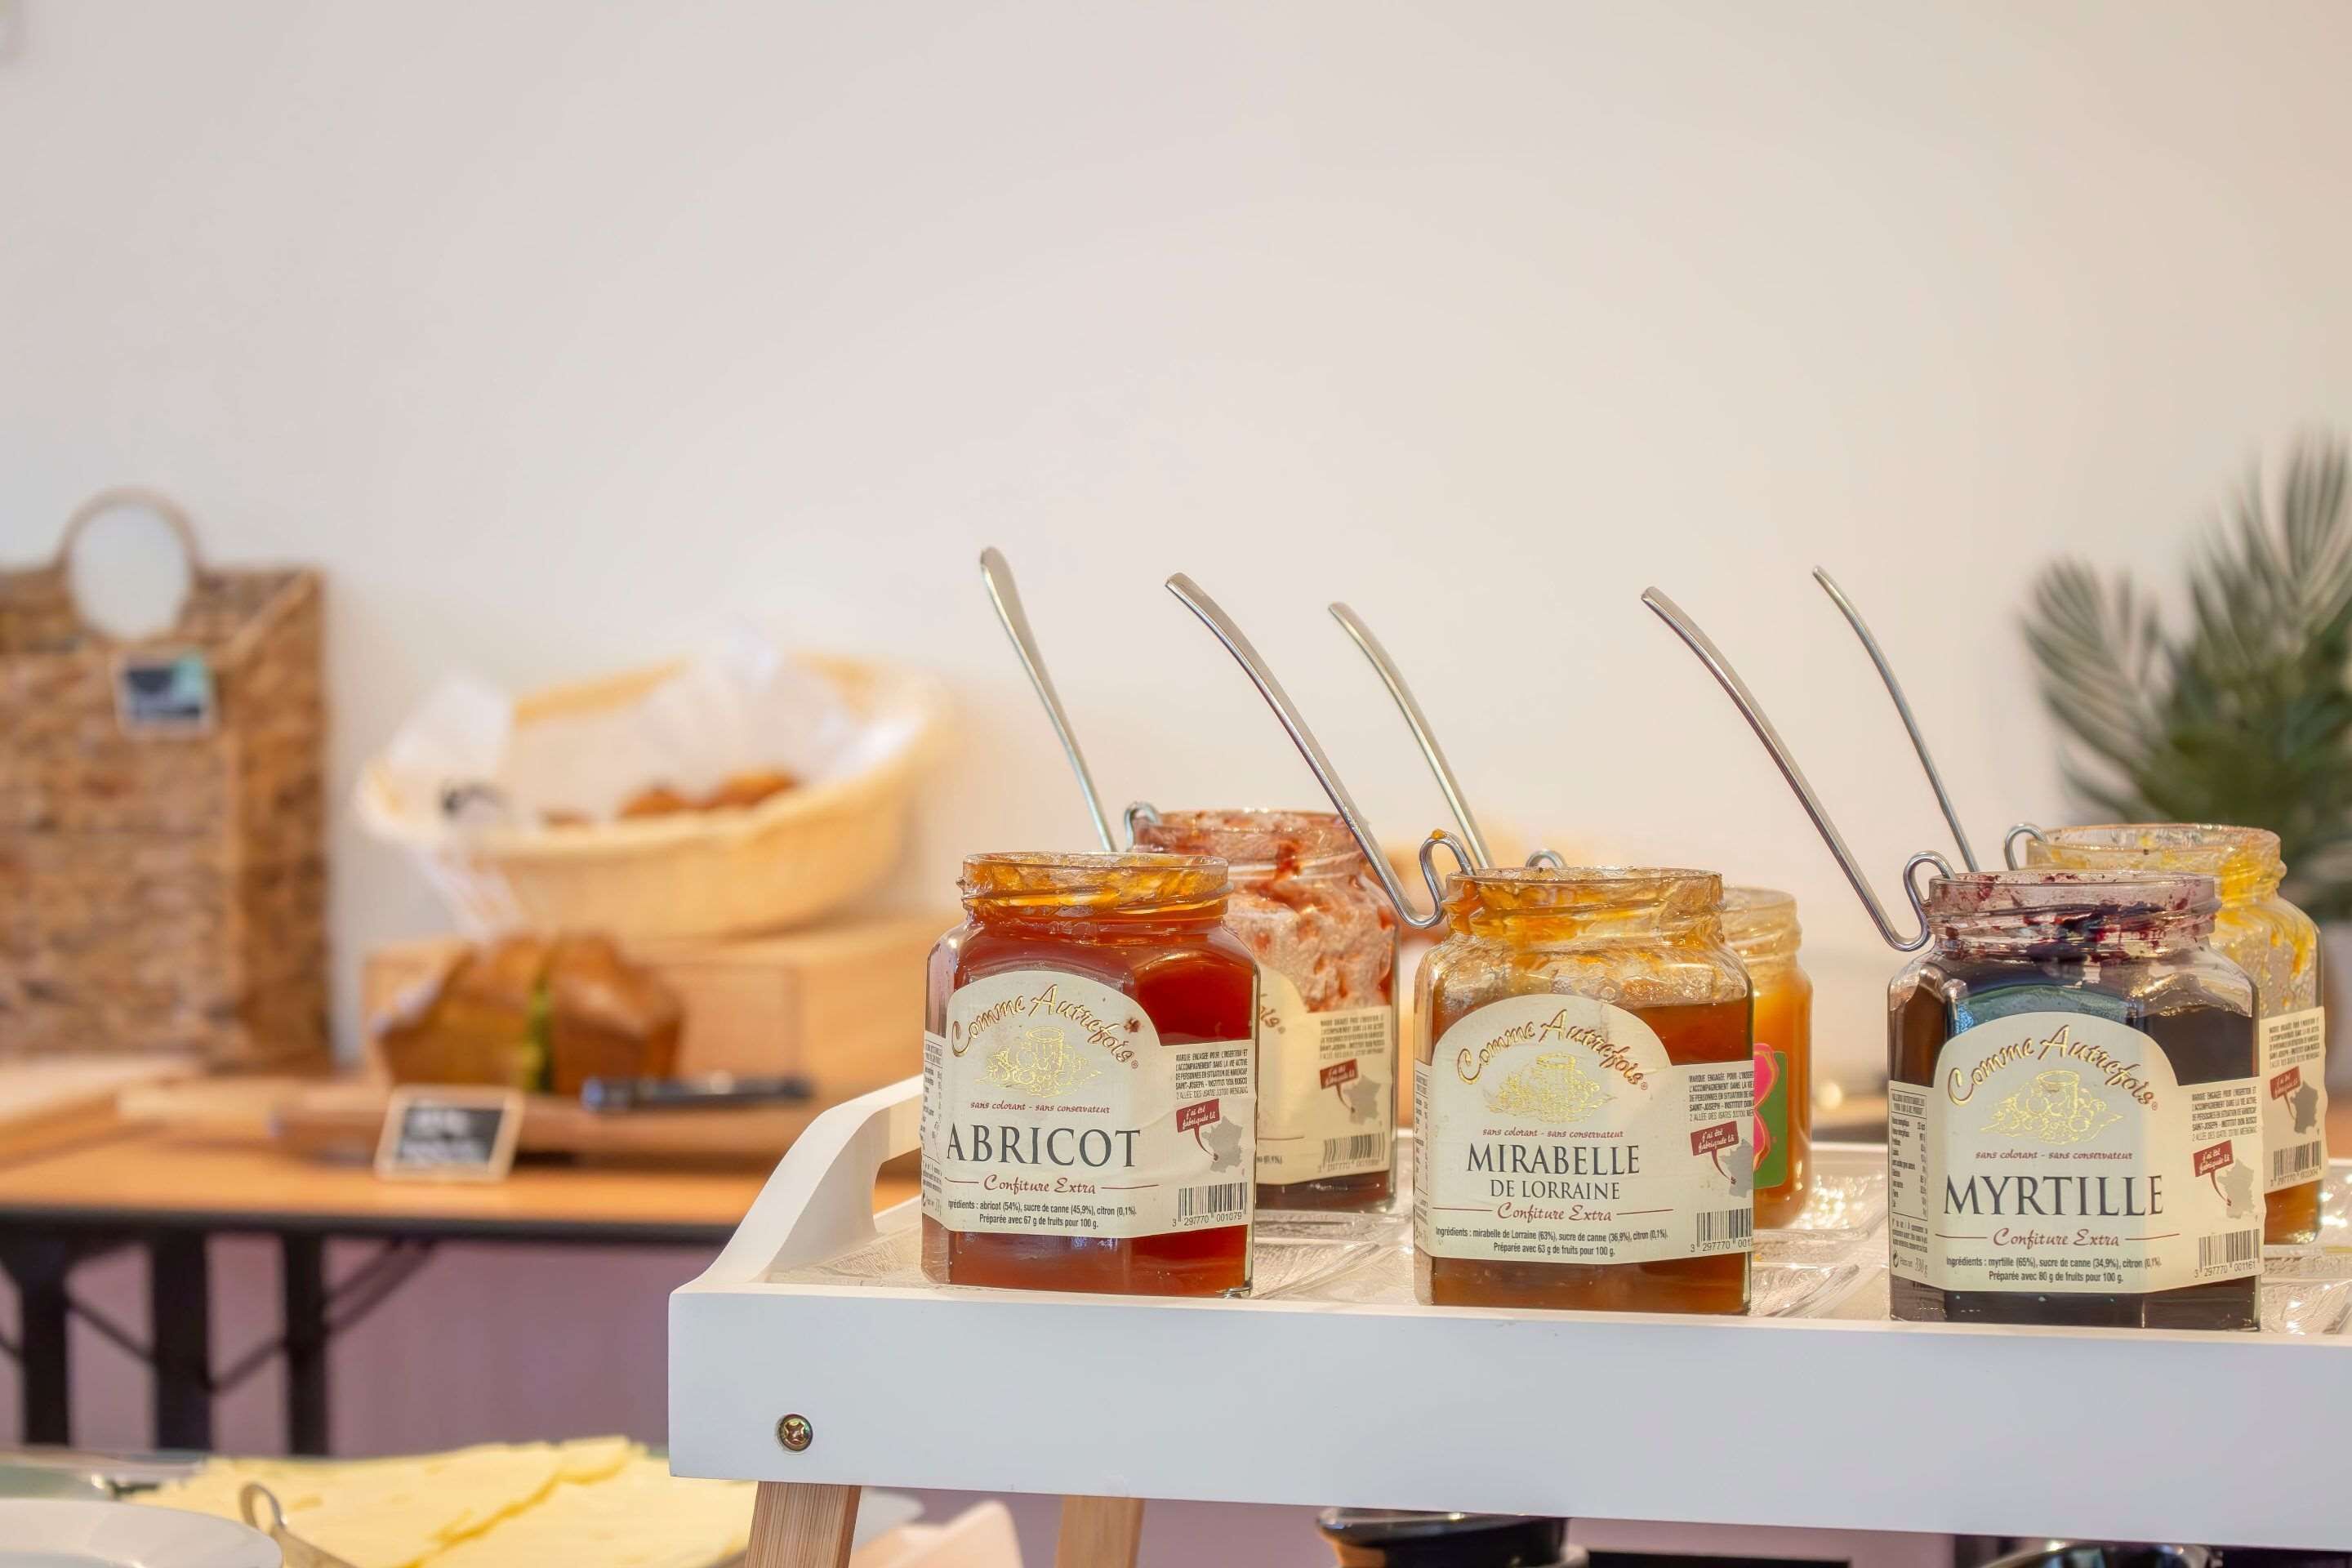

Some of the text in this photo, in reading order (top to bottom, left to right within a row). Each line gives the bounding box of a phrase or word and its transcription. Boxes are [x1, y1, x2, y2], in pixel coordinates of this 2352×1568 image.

[951, 995, 1026, 1058] Comme
[1457, 1021, 1536, 1085] Comme
[1948, 1038, 2034, 1107] Comme
[991, 1100, 1026, 1111] colorant
[1035, 1104, 1054, 1112] sans
[1057, 1104, 1110, 1114] conservateur
[1504, 1127, 1538, 1137] colorant
[1569, 1129, 1624, 1139] conservateur
[946, 1122, 1141, 1168] ABRICOT
[1466, 1143, 1640, 1176] MIRABELLE
[1976, 1151, 1997, 1160] sans
[2000, 1148, 2038, 1160] colorant
[2049, 1152, 2070, 1160] sans
[2073, 1151, 2133, 1160] conservateur
[983, 1174, 1096, 1196] Confiture Extra
[1490, 1179, 1620, 1200] DE LORRAINE
[1944, 1174, 2163, 1216] MYRTILLE
[980, 1201, 1001, 1210] abricot
[1003, 1202, 1022, 1213] (54%),
[1042, 1204, 1049, 1212] de
[1051, 1205, 1069, 1214] canne
[1097, 1206, 1115, 1215] citron
[1497, 1202, 1612, 1223] Confiture Extra
[980, 1214, 1007, 1225] Préparée
[1023, 1216, 1031, 1224] 67
[1033, 1217, 1037, 1226] g
[1038, 1216, 1046, 1225] de
[1048, 1216, 1063, 1226] fruits
[1065, 1219, 1079, 1228] pour
[1080, 1218, 1091, 1227] 100
[1172, 1212, 1242, 1227] 3 297770 001079
[1436, 1226, 1468, 1238] Ingrédients
[1473, 1228, 1501, 1238] mirabelle
[1503, 1229, 1510, 1238] de
[1511, 1229, 1536, 1239] Lorraine
[1538, 1231, 1557, 1241] (63%),
[1559, 1233, 1576, 1241] sucre
[1578, 1232, 1585, 1242] de
[1587, 1234, 1606, 1242] canne
[1633, 1230, 1649, 1240] citron
[1993, 1228, 2119, 1250] Confiture Extra
[1494, 1242, 1615, 1257] Préparée avec 63 g de fruits pour 100 g.
[1690, 1244, 1695, 1253] 3
[1702, 1241, 1731, 1252] 297770
[1946, 1256, 1982, 1268] Ingrédients
[1988, 1257, 2013, 1268] myrtille
[2016, 1257, 2038, 1268] (65%),
[2039, 1258, 2058, 1267] sucre
[2060, 1258, 2068, 1267] de
[2070, 1258, 2091, 1267] canne
[2122, 1258, 2143, 1268] citron
[1989, 1270, 2019, 1282] Préparée
[2021, 1272, 2037, 1281] avec
[2038, 1271, 2047, 1281] 80
[2049, 1273, 2053, 1283] g
[2055, 1272, 2063, 1281] de
[2065, 1272, 2084, 1281] fruits
[2085, 1274, 2101, 1283] pour
[2103, 1272, 2116, 1282] 100
